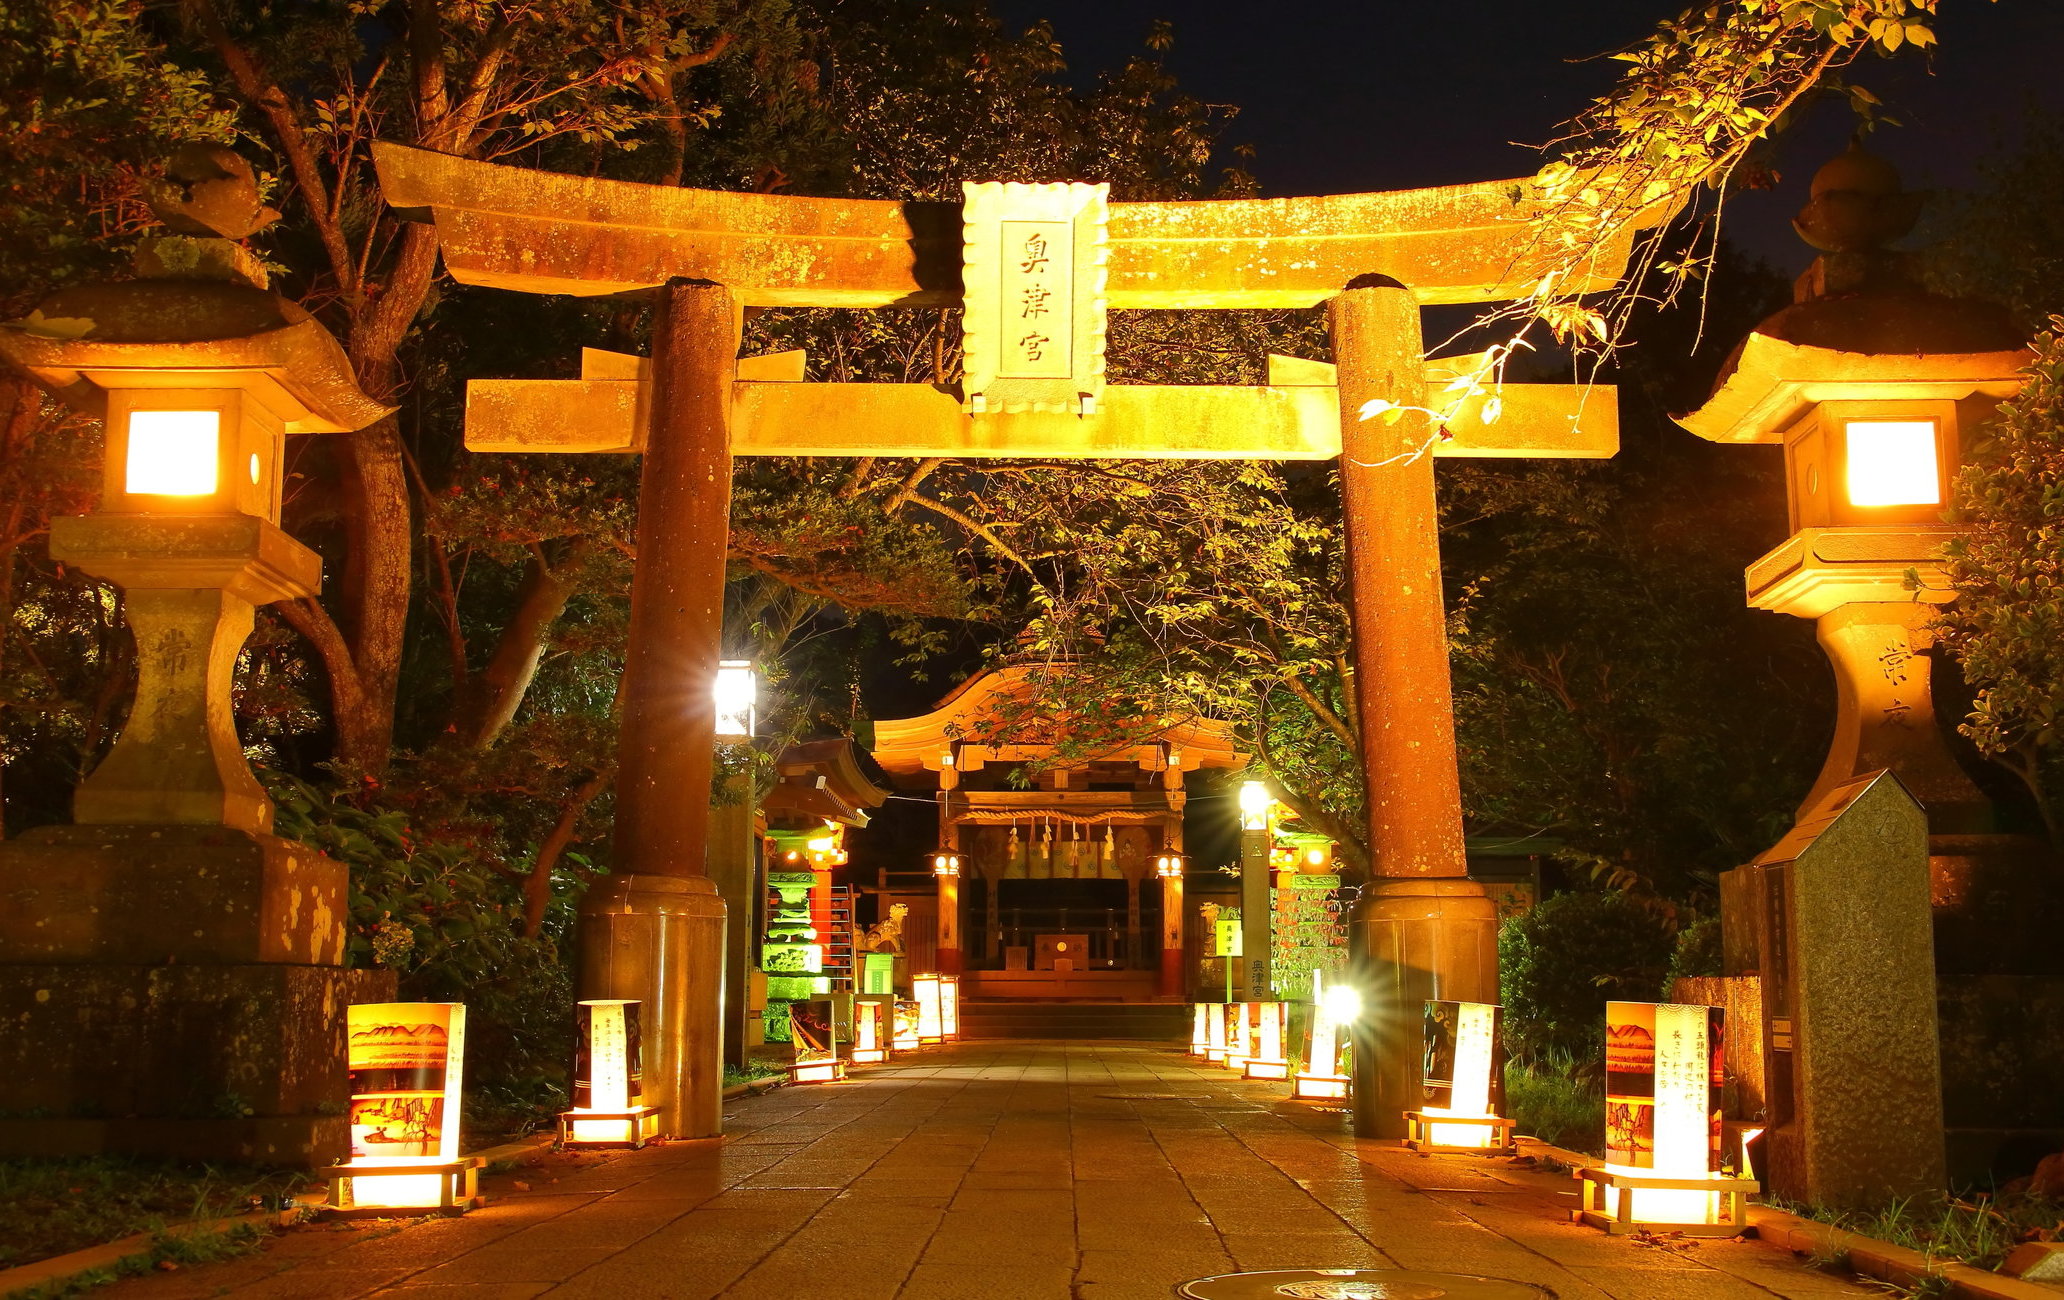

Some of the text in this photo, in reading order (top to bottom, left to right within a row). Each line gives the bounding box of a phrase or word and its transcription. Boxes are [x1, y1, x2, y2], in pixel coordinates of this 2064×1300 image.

[1020, 233, 1051, 362] 奥津宮
[1252, 960, 1265, 998] 奥津宮
